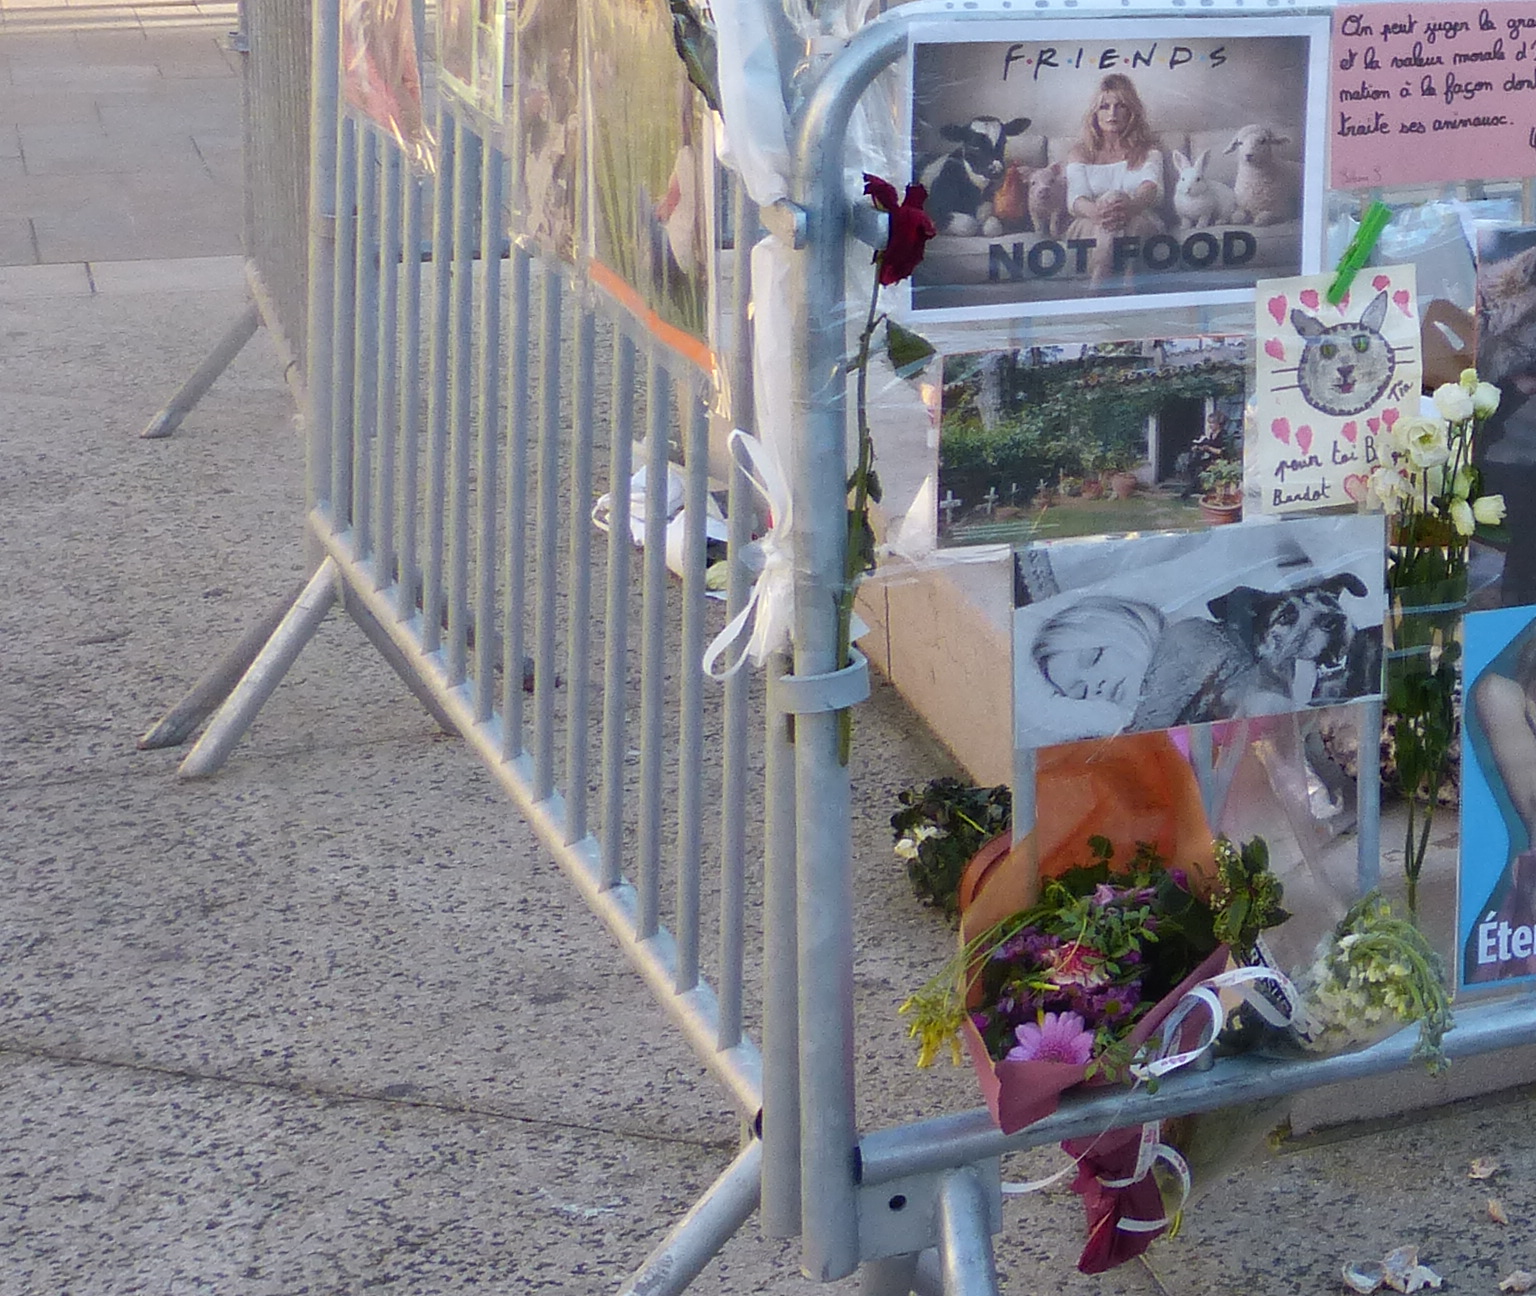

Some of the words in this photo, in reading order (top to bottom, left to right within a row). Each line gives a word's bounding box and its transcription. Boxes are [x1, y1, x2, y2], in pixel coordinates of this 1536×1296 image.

[1342, 14, 1373, 36] On
[1380, 14, 1417, 41] peut
[1424, 19, 1470, 43] juger
[1479, 9, 1496, 30] la
[1339, 49, 1357, 70] et
[1364, 47, 1381, 69] la
[1390, 41, 1444, 68] valeur
[1453, 38, 1505, 63] morale
[1421, 75, 1436, 96] la
[1445, 72, 1493, 104] façon
[1338, 112, 1390, 136] traite
[1399, 118, 1426, 133] ses
[1432, 114, 1515, 130] animaux.
[989, 238, 1097, 281] NOT
[1113, 230, 1257, 271] FOOD
[1387, 380, 1413, 402] Tia
[1275, 455, 1323, 482] pour
[1332, 440, 1358, 465] toi
[1273, 476, 1331, 507] Bardot
